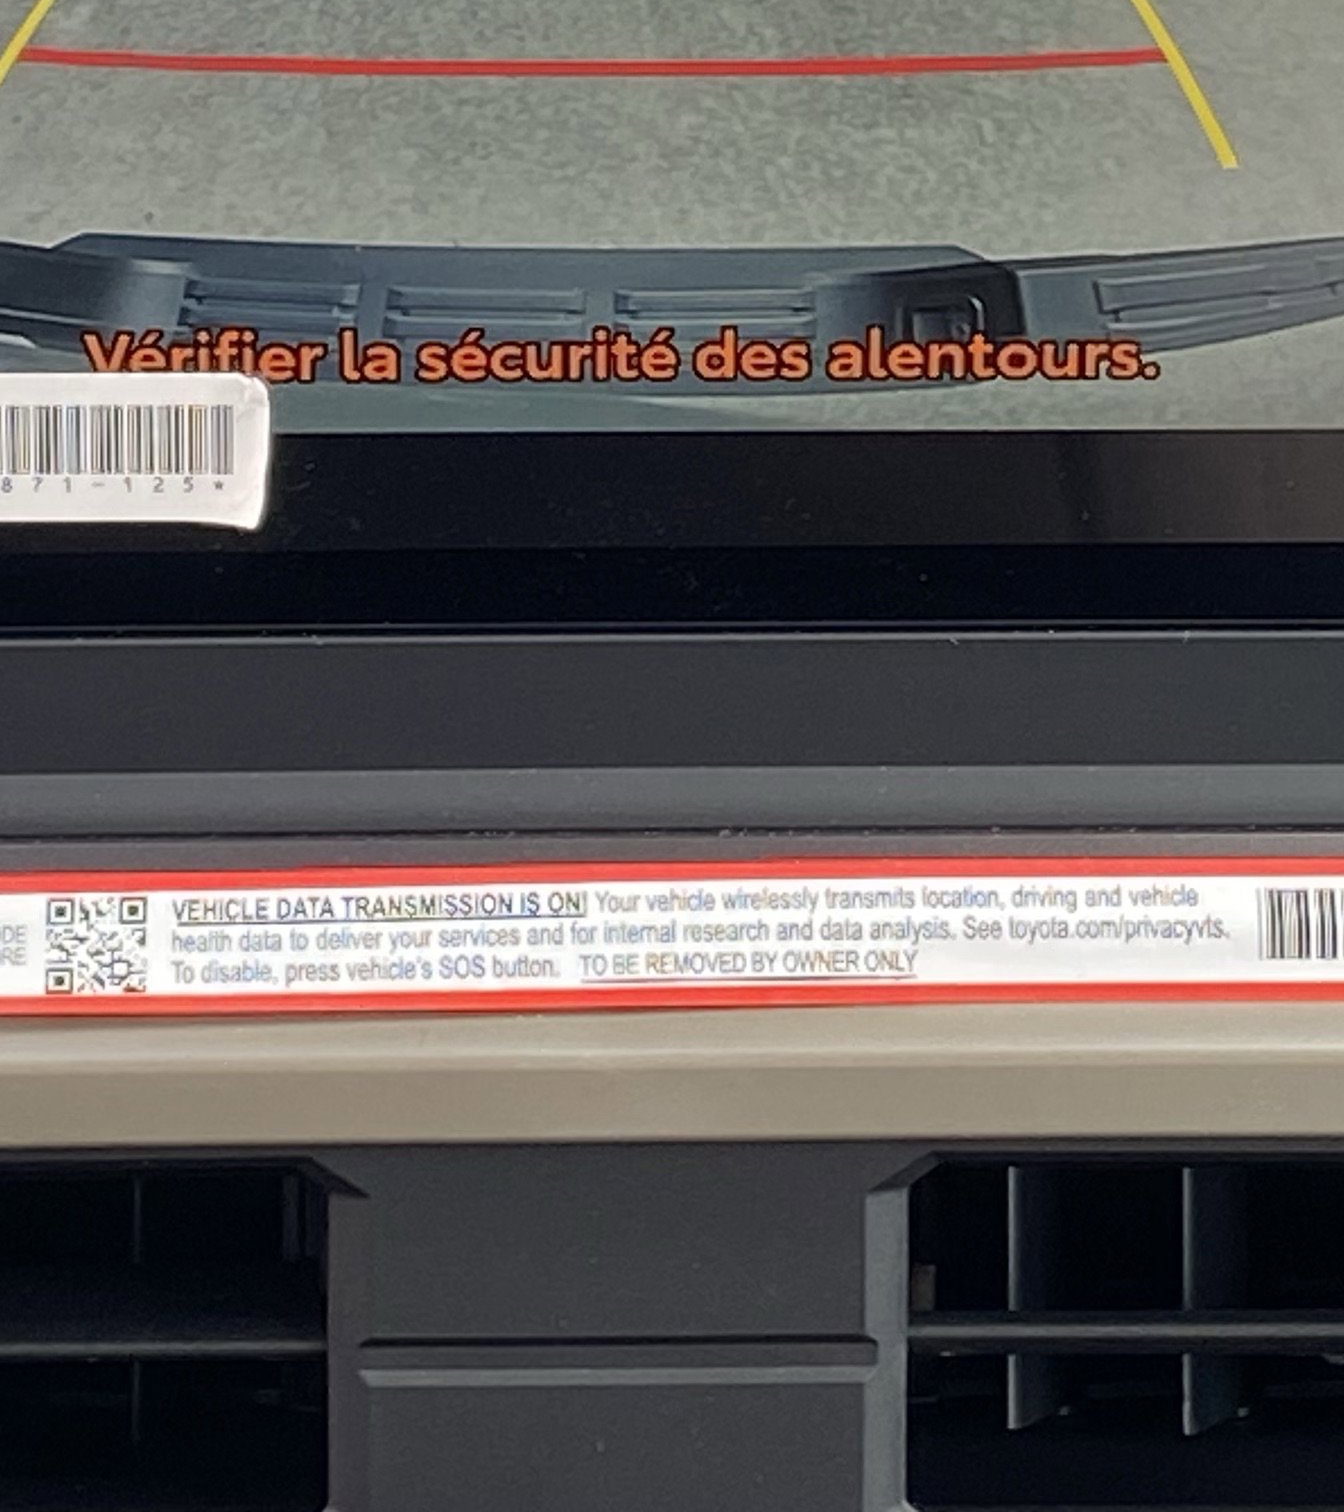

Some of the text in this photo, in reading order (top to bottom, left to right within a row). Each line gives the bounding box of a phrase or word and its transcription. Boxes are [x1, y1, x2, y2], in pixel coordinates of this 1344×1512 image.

[81, 325, 1160, 383] Vérifier la sécurité des alentours.
[172, 897, 268, 921] VEHICLE
[276, 896, 335, 919] DATA
[342, 892, 513, 919] TRANSMISSION
[520, 892, 539, 916] IS
[595, 890, 638, 913] Your
[645, 888, 715, 912] vehicle
[721, 886, 819, 914] wirelessly
[825, 886, 916, 909] transmits
[922, 885, 1005, 910] location,
[1012, 885, 1077, 913] driving
[1085, 885, 1121, 907] and
[1128, 884, 1199, 907] vehicle
[171, 915, 1230, 954] health data to deliver your services and for internal research and data analysis. See toyota.com/privacyvts.
[170, 949, 918, 987] To disable, press vehicle's SOS button. TO BE REMOVED BY OWNER ONLY
